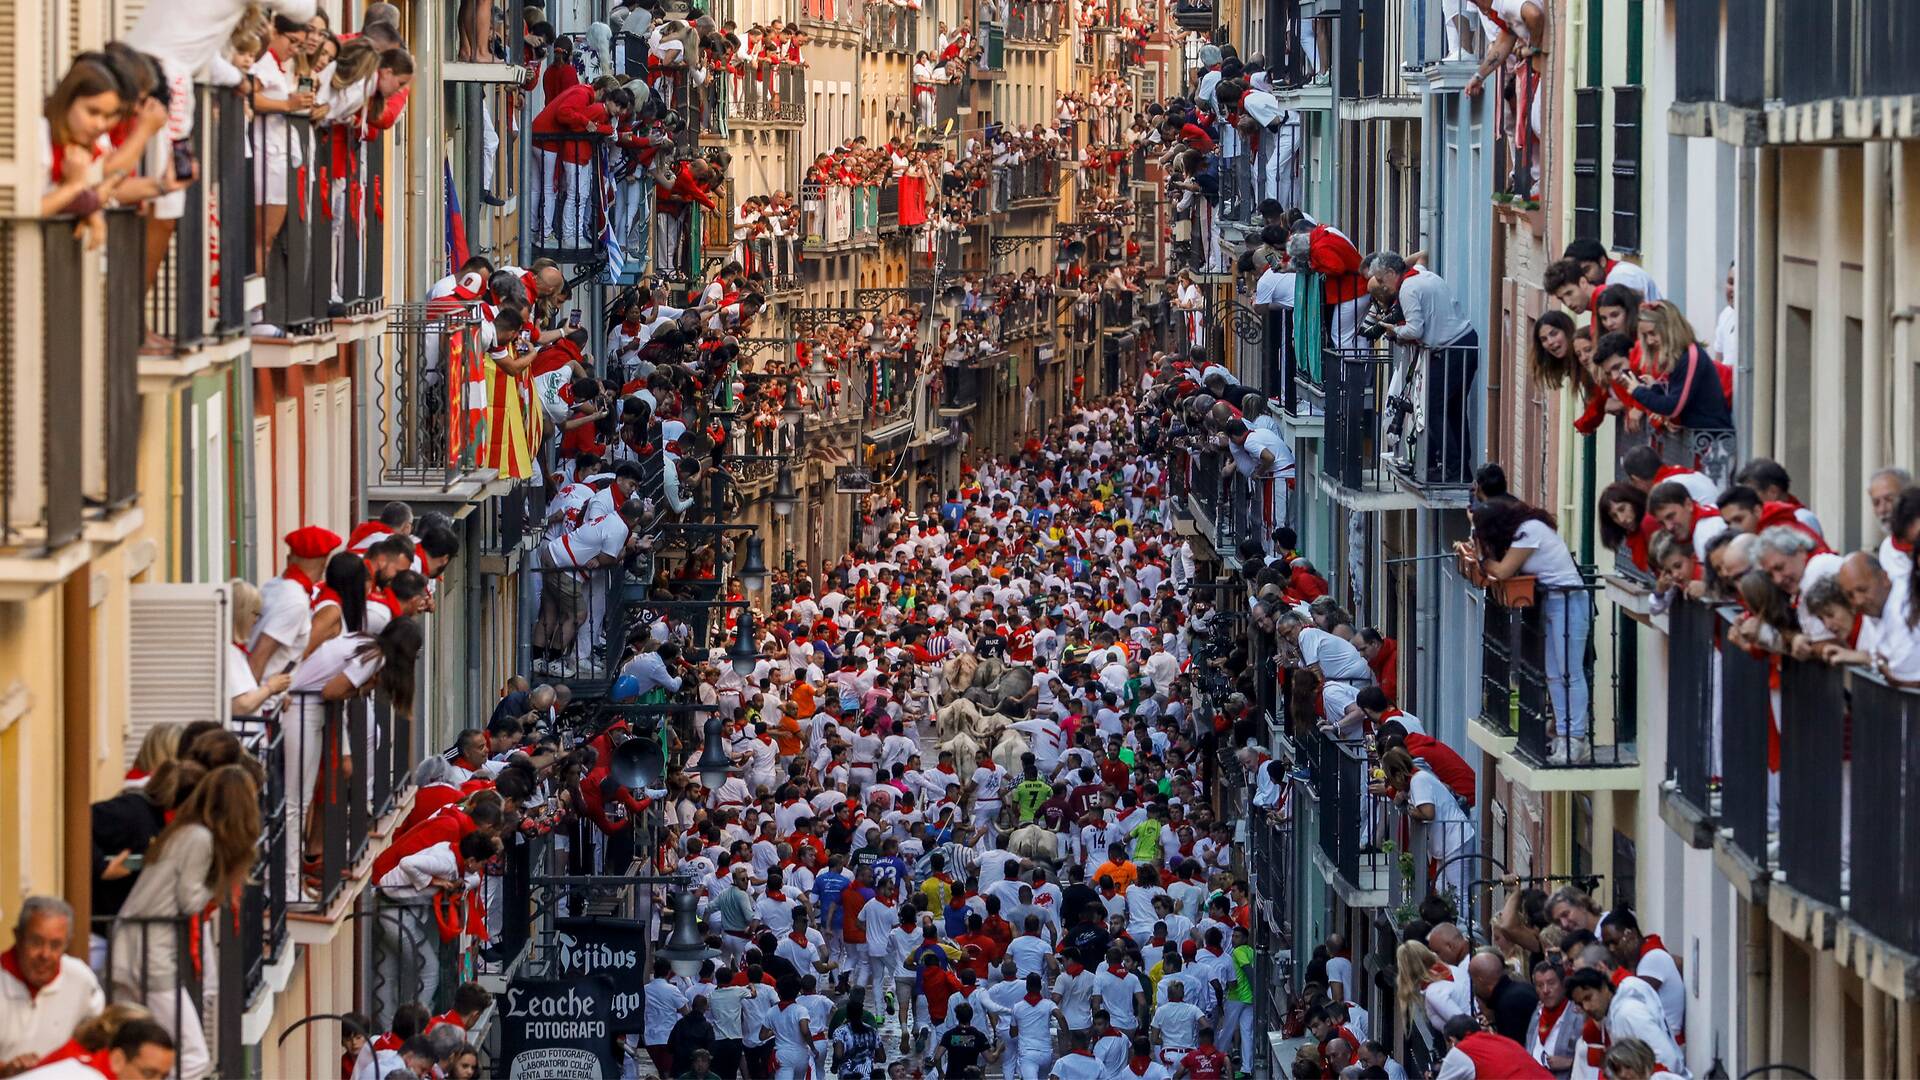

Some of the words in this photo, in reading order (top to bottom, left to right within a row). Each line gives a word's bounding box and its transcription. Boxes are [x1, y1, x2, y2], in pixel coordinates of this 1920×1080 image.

[1015, 630, 1033, 649] 23
[988, 646, 996, 656] 4
[1029, 791, 1039, 808] 7
[1093, 831, 1106, 849] 14
[559, 932, 637, 976] Tejidos
[506, 987, 595, 1019] Leache
[525, 1021, 606, 1040] FOTOGRAFO
[517, 1049, 547, 1064] ESTUDIO
[548, 1049, 597, 1064] FOTOGRAFICO
[521, 1059, 569, 1072] LABORATORIO
[570, 1060, 594, 1072] COLOR
[517, 1070, 541, 1080] VENTA
[544, 1069, 553, 1078] DE
[556, 1069, 594, 1080] MATERIAL
